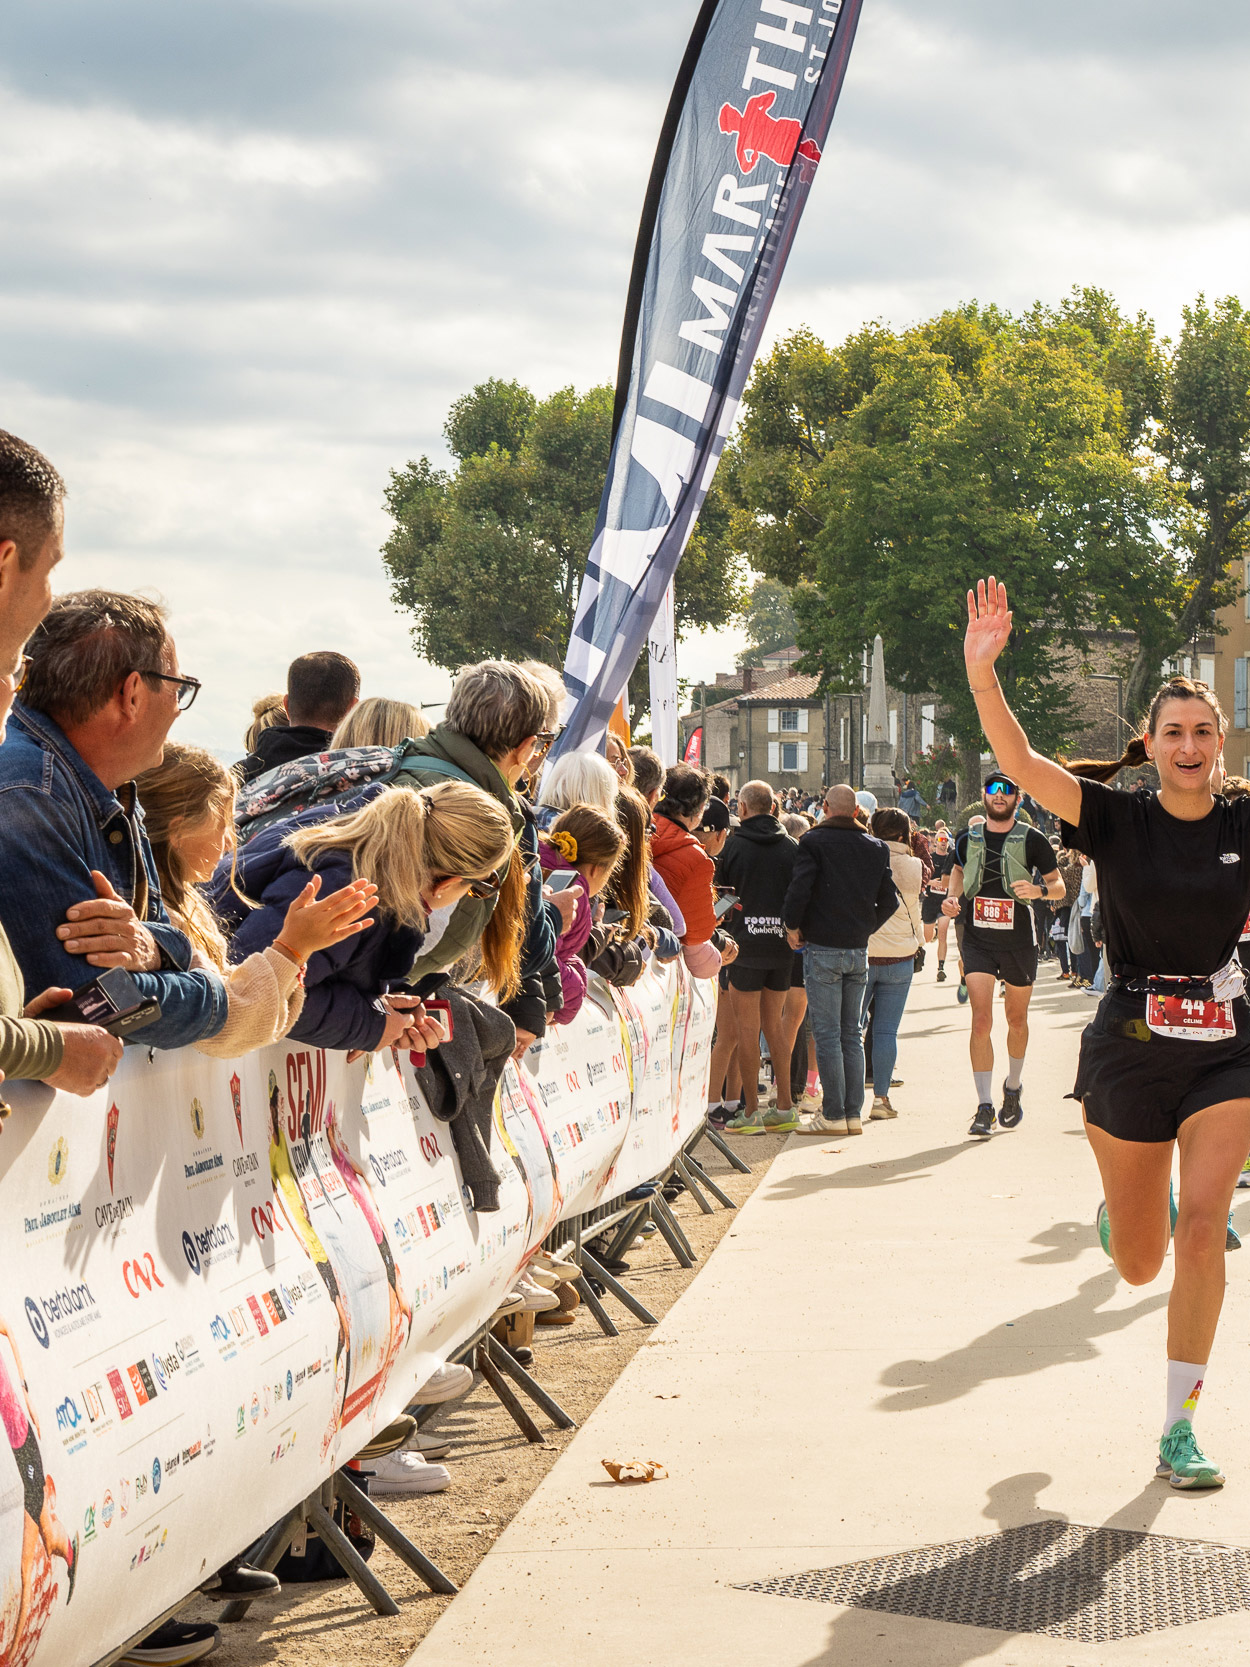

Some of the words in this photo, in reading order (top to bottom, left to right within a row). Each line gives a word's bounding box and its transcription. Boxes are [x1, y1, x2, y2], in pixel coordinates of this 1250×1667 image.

[983, 905, 1000, 919] 886
[1181, 998, 1206, 1016] 44
[286, 1047, 327, 1143] SEMI
[420, 1132, 443, 1163] CNR
[24, 1217, 39, 1234] PAUL
[39, 1208, 68, 1229] JABOULET
[94, 1202, 114, 1229] CAVE
[117, 1195, 136, 1220] TAIN
[251, 1200, 284, 1240] CNR
[194, 1216, 235, 1256] bertolami
[122, 1251, 165, 1299] CNR
[39, 1276, 96, 1323] bertolami
[55, 1396, 82, 1432] ATOL
[80, 1382, 106, 1424] LDT
